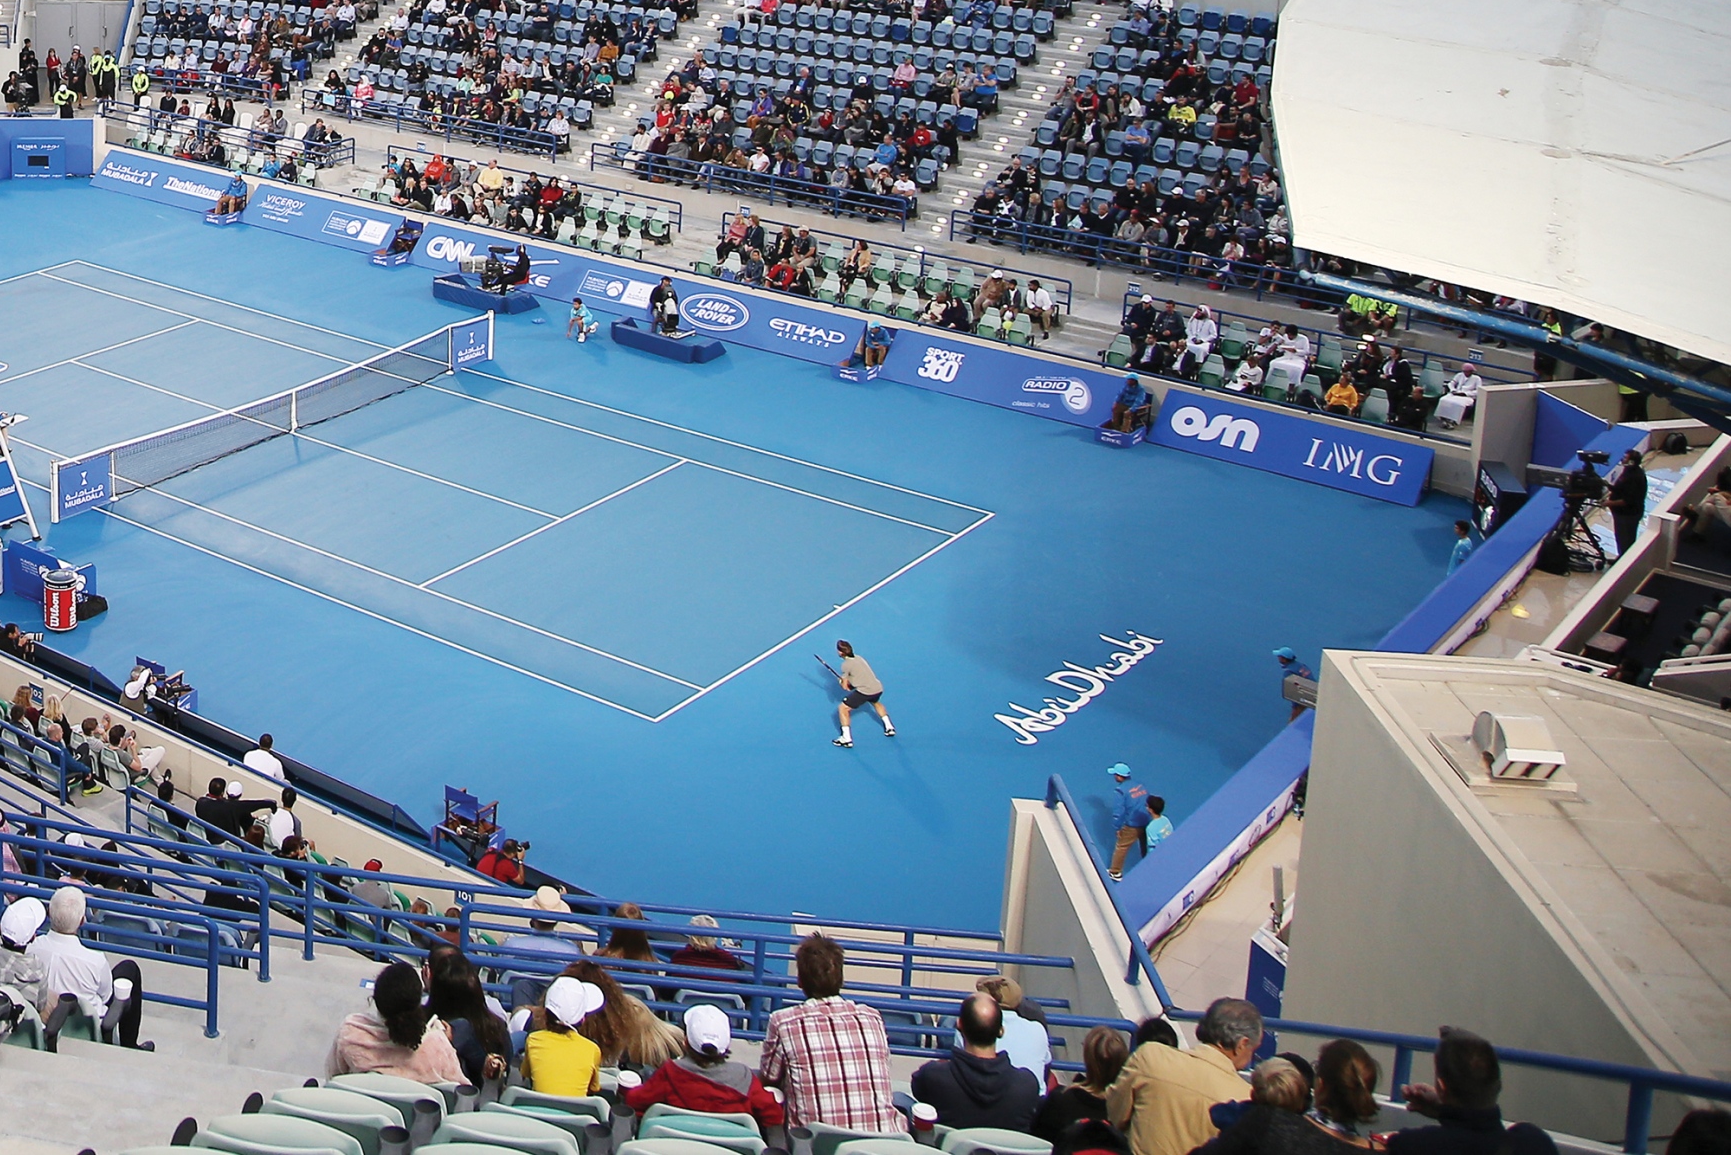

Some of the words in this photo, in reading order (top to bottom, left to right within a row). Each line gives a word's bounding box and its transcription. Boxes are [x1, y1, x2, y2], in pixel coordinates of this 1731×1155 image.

[100, 168, 146, 185] MUBADALA
[267, 194, 307, 210] VICEROY
[426, 236, 476, 262] CNN
[696, 298, 730, 314] LAND
[695, 309, 736, 326] ROVER
[769, 317, 845, 344] ETIHAD
[777, 332, 830, 348] AIRWAYS
[917, 355, 960, 383] 360
[1025, 380, 1067, 390] RADIO
[1069, 387, 1085, 406] 2
[1302, 438, 1403, 486] IMG
[65, 490, 105, 509] MUBADALA
[50, 592, 60, 627] Wilson
[458, 890, 472, 903] 101
